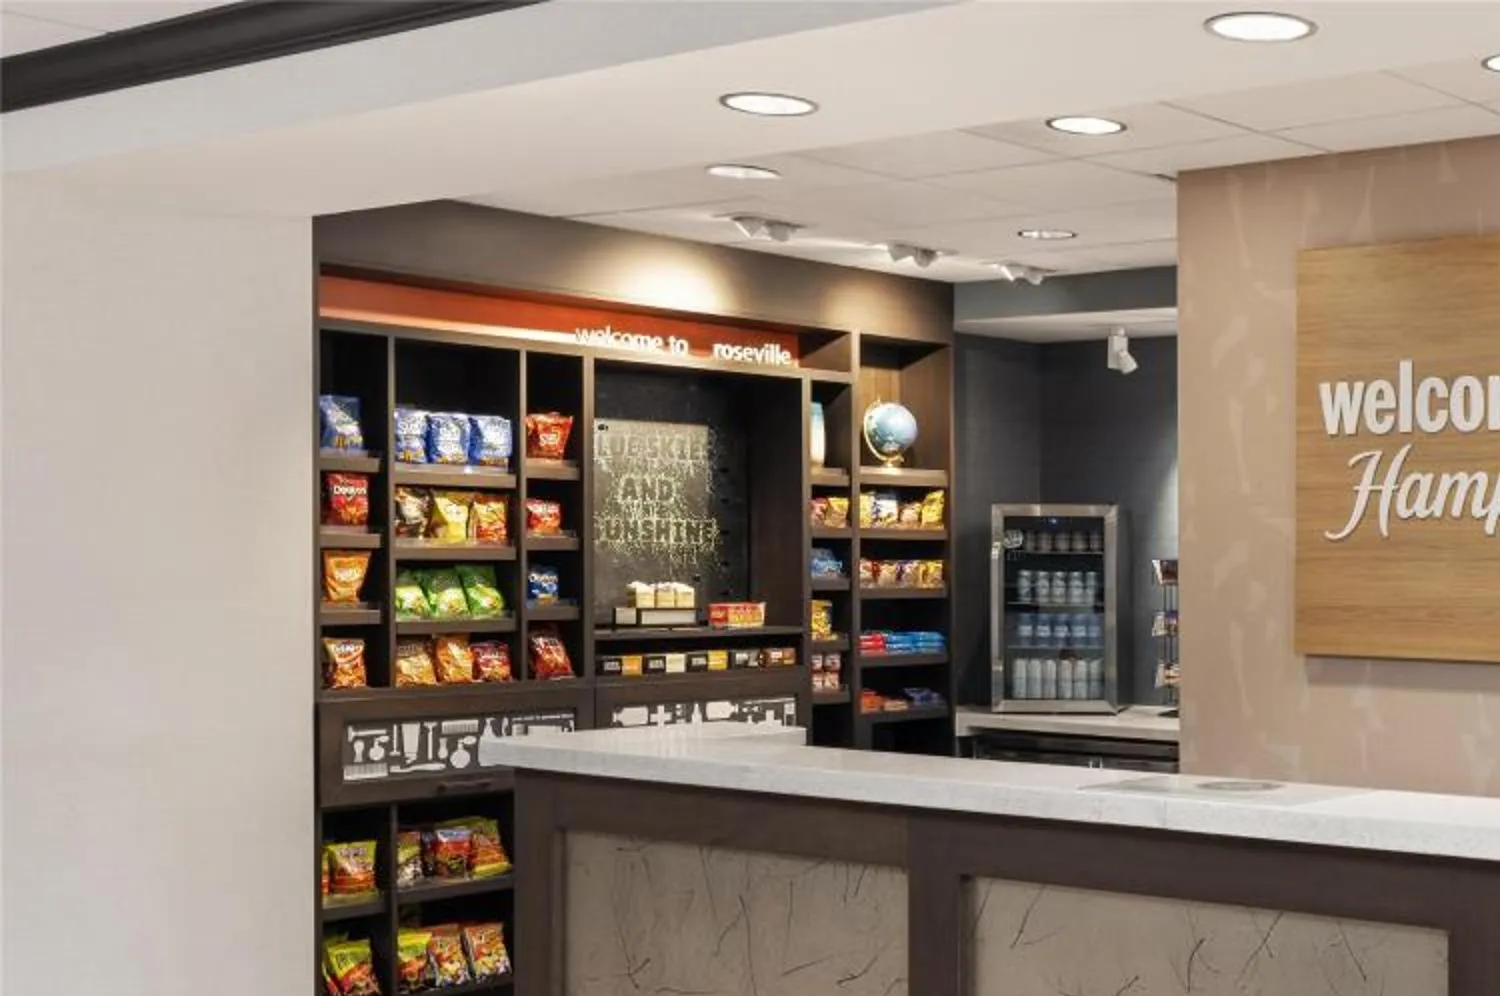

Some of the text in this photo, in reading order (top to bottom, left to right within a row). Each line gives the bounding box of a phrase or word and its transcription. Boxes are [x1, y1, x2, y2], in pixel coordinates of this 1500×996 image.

[575, 325, 792, 365] welcome to roseville
[619, 477, 676, 502] AND
